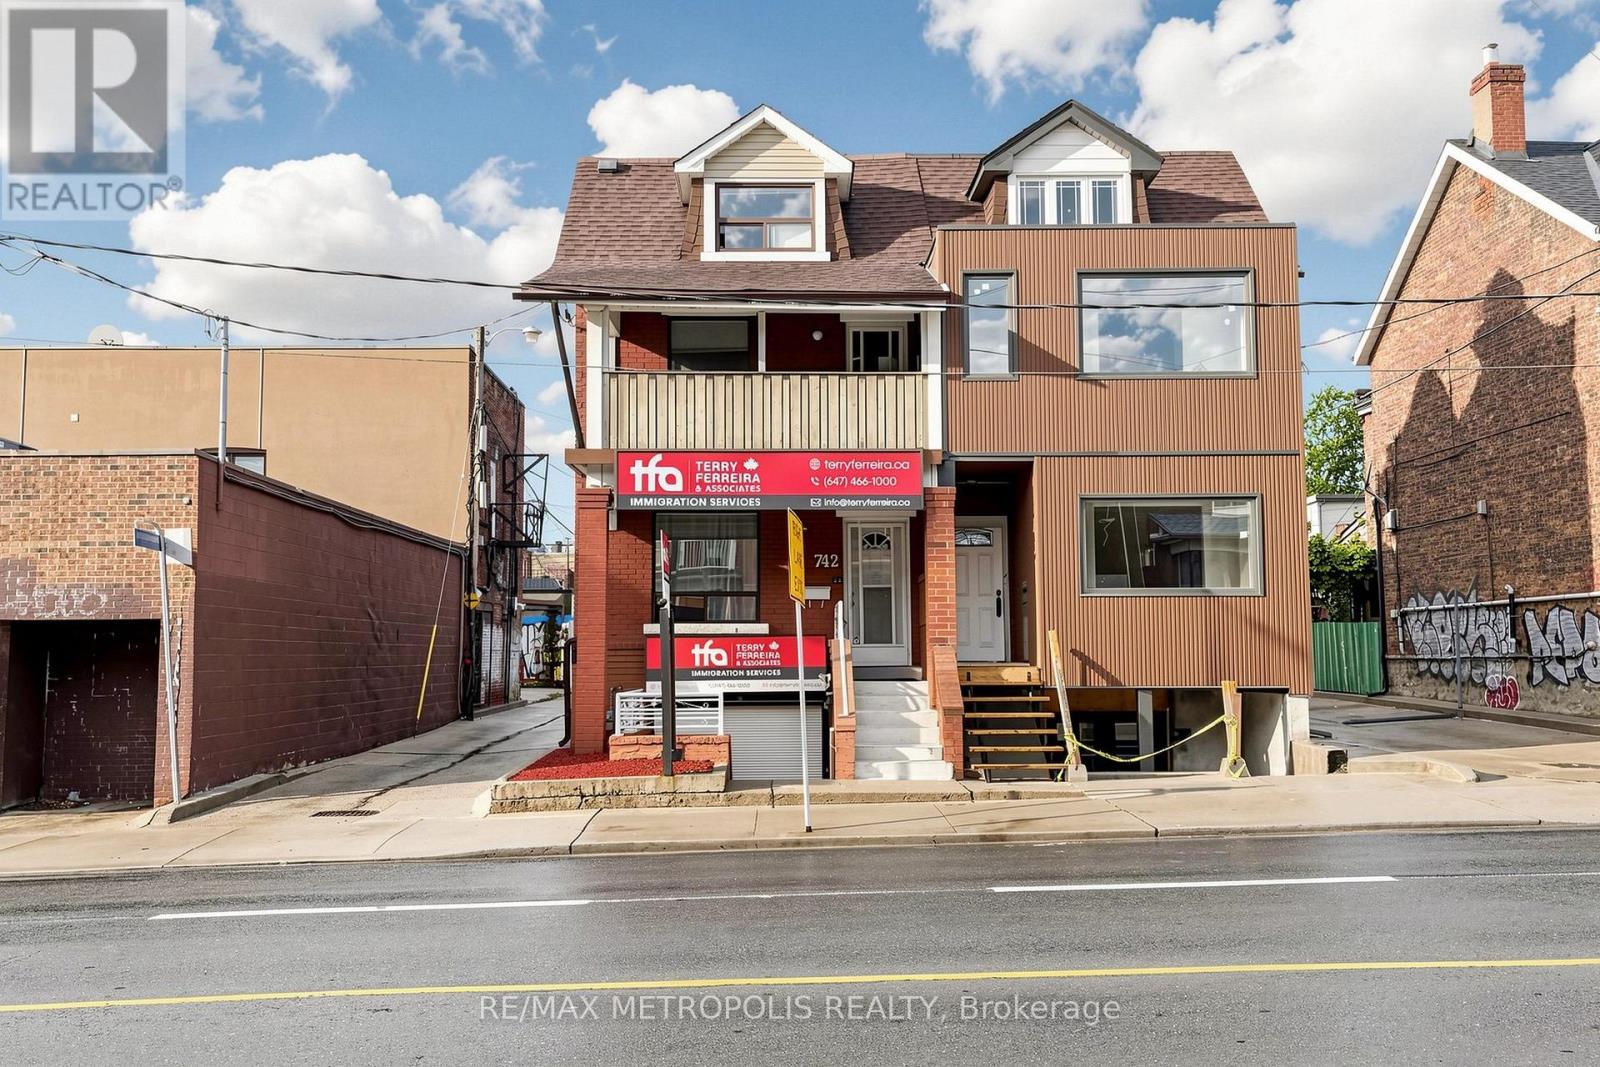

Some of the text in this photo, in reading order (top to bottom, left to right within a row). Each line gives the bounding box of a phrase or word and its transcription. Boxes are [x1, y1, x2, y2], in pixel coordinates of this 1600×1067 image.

[695, 461, 738, 472] TERRY
[824, 458, 910, 471] terryferreira.ca
[630, 453, 683, 492] tfa
[695, 473, 760, 483] FERREIRA
[823, 476, 897, 488] (647) 466-1000
[705, 485, 761, 493] ASSOCIATES
[630, 497, 707, 507] IMMIGRATION
[814, 554, 839, 568] 742
[691, 640, 728, 667] tfa
[736, 644, 765, 652] TERRY
